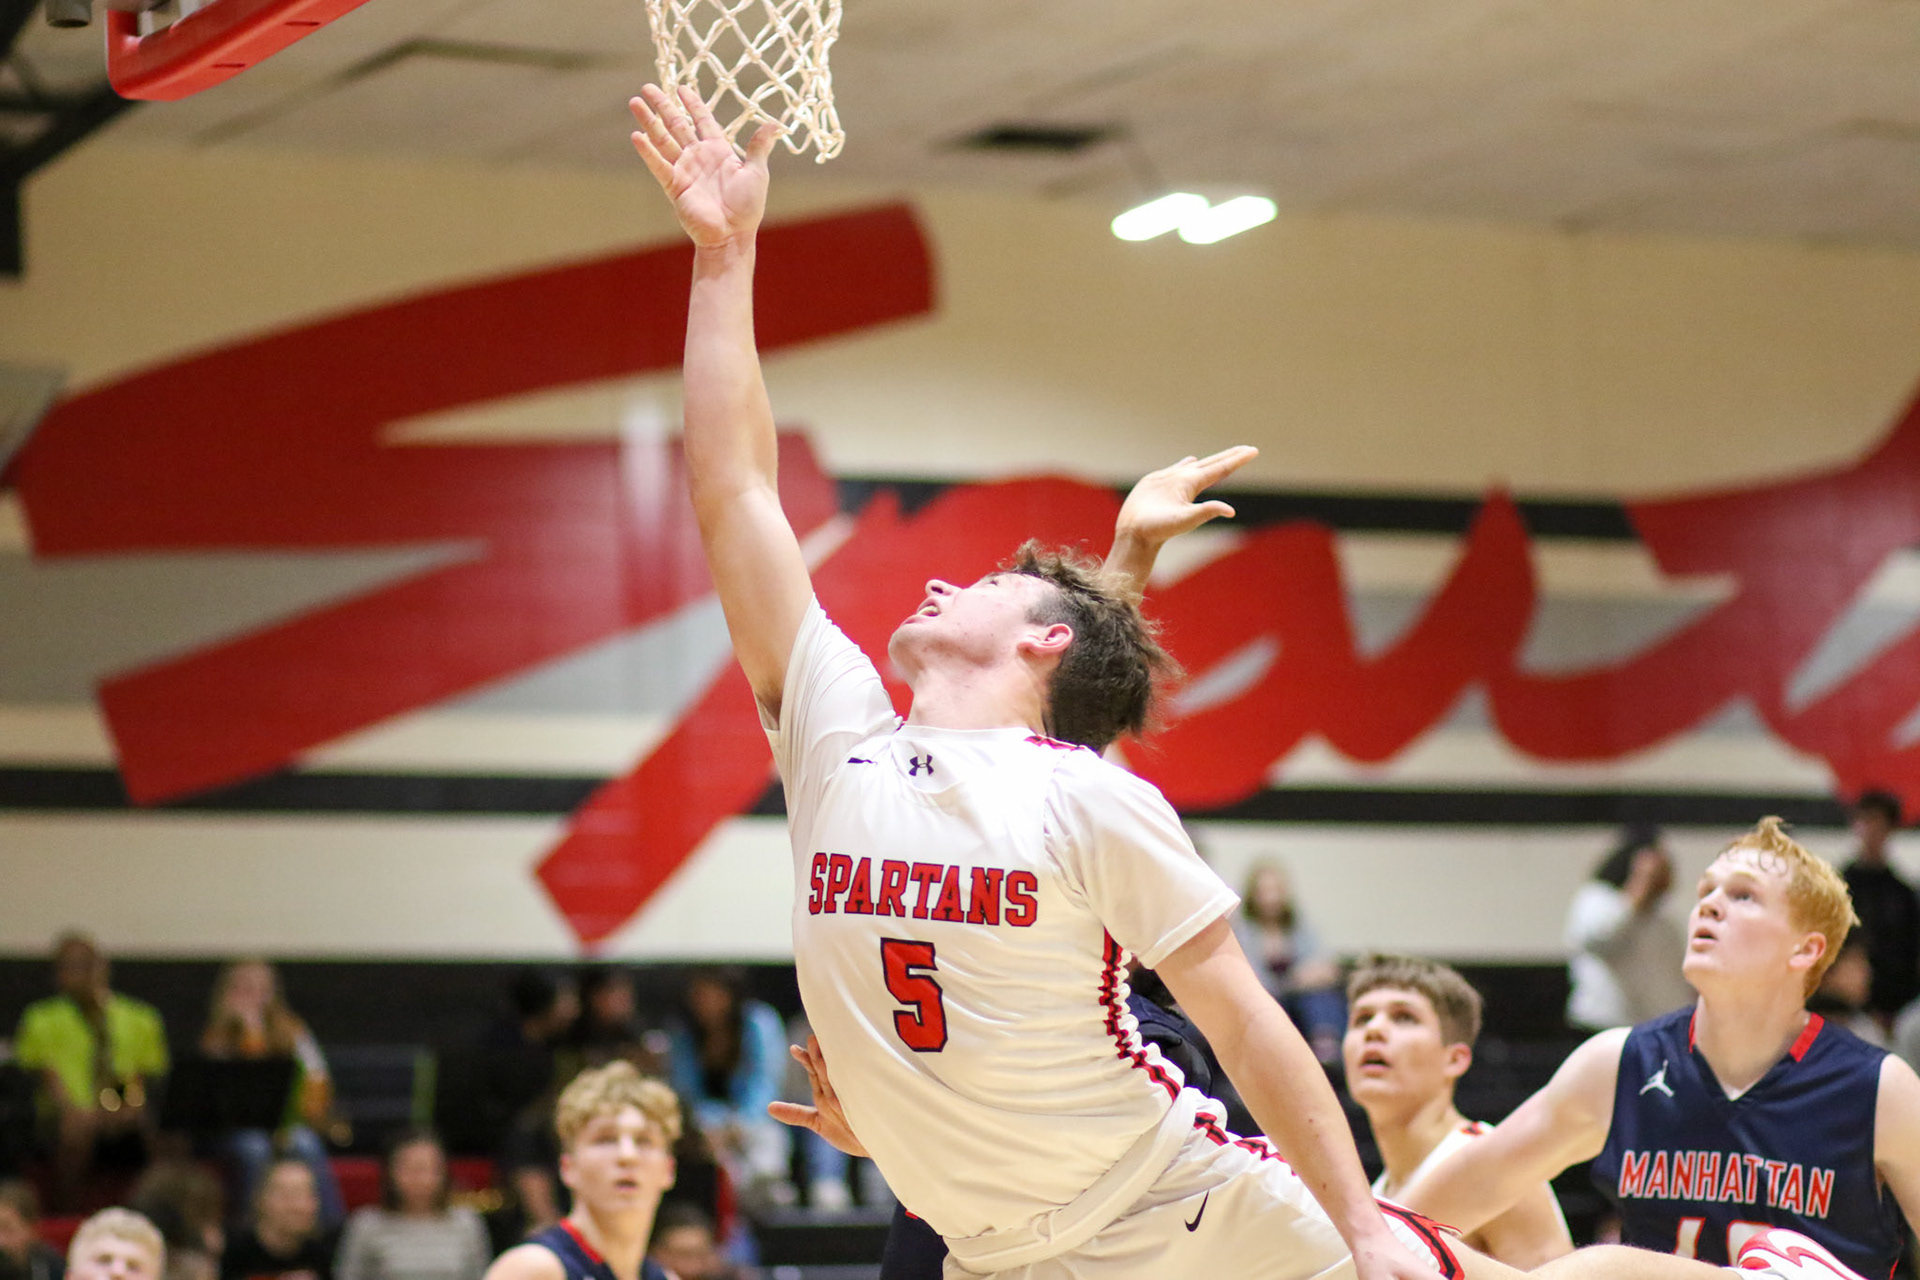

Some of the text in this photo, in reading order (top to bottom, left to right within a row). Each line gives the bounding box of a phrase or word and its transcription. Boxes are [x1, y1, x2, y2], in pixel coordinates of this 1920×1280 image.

[808, 852, 1039, 928] SPARTANS
[880, 936, 948, 1053] 5
[1618, 1150, 1836, 1220] MANHATTAN
